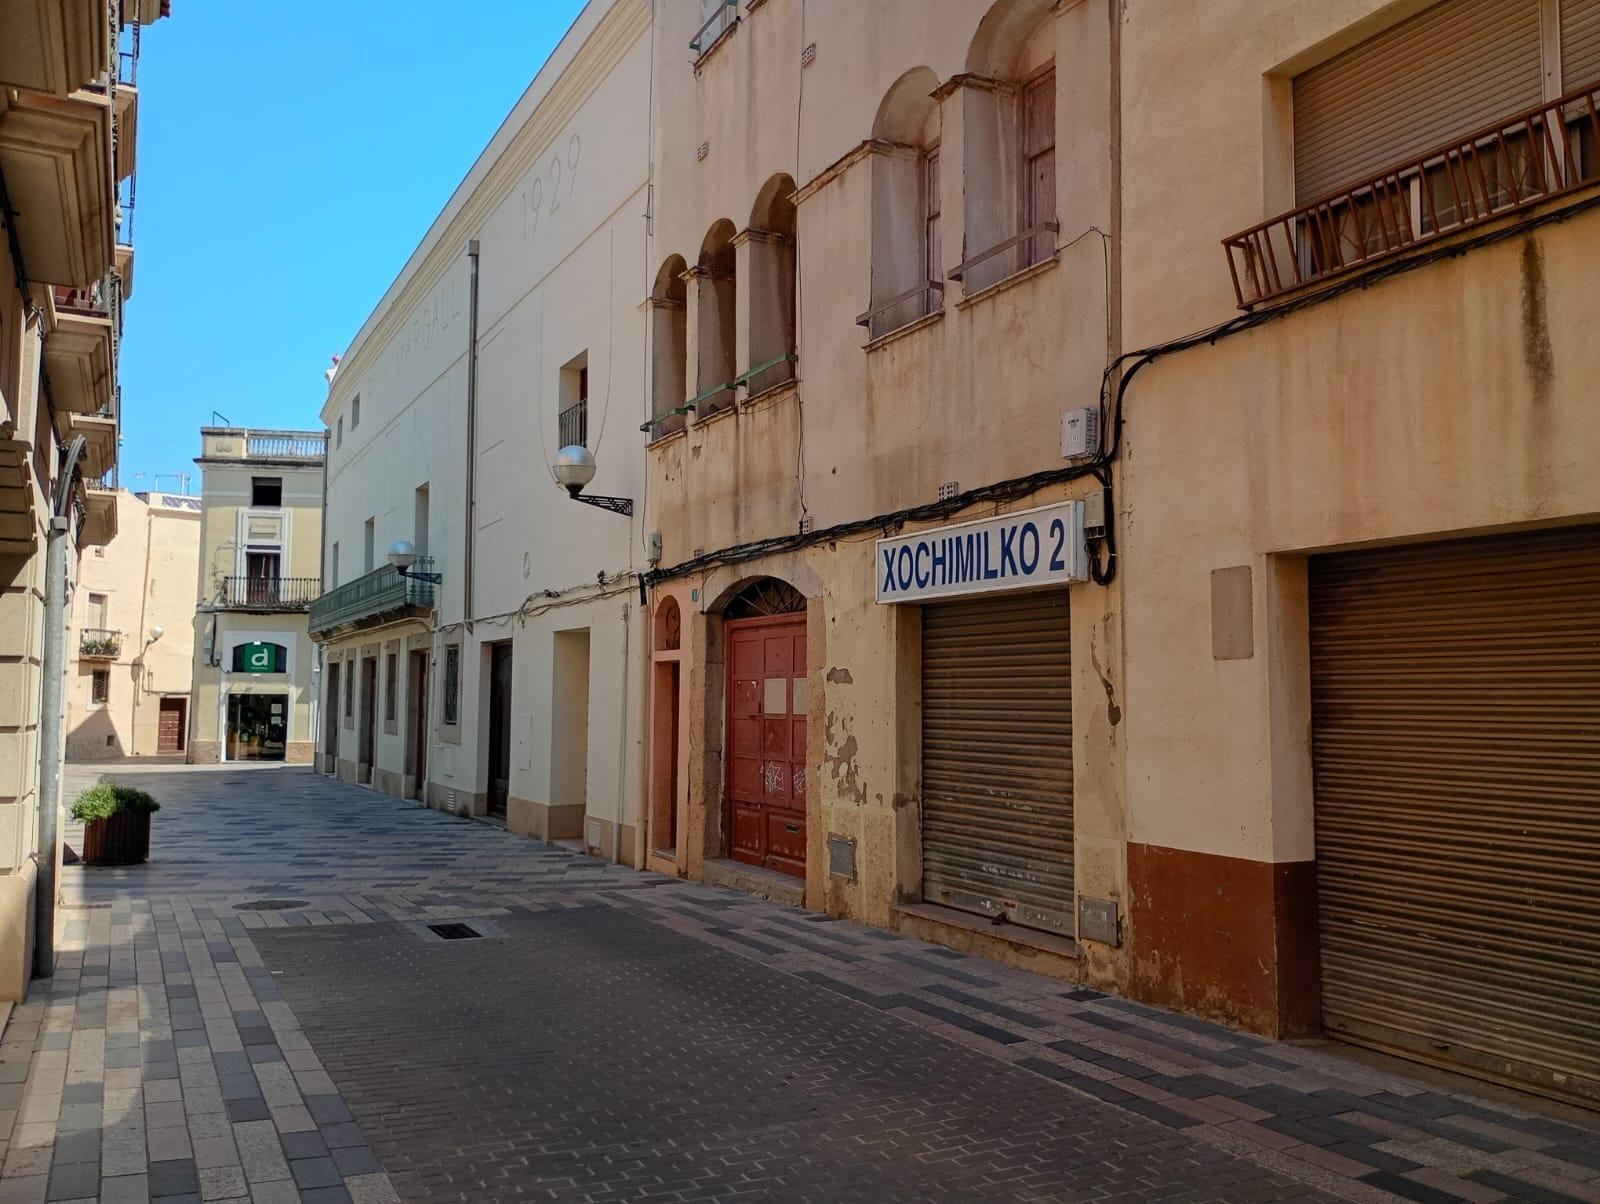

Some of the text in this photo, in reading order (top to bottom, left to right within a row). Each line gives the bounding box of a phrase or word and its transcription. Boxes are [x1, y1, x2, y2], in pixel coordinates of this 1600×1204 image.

[522, 133, 581, 245] 1929
[882, 518, 1065, 593] XOCHIMILKO 2
